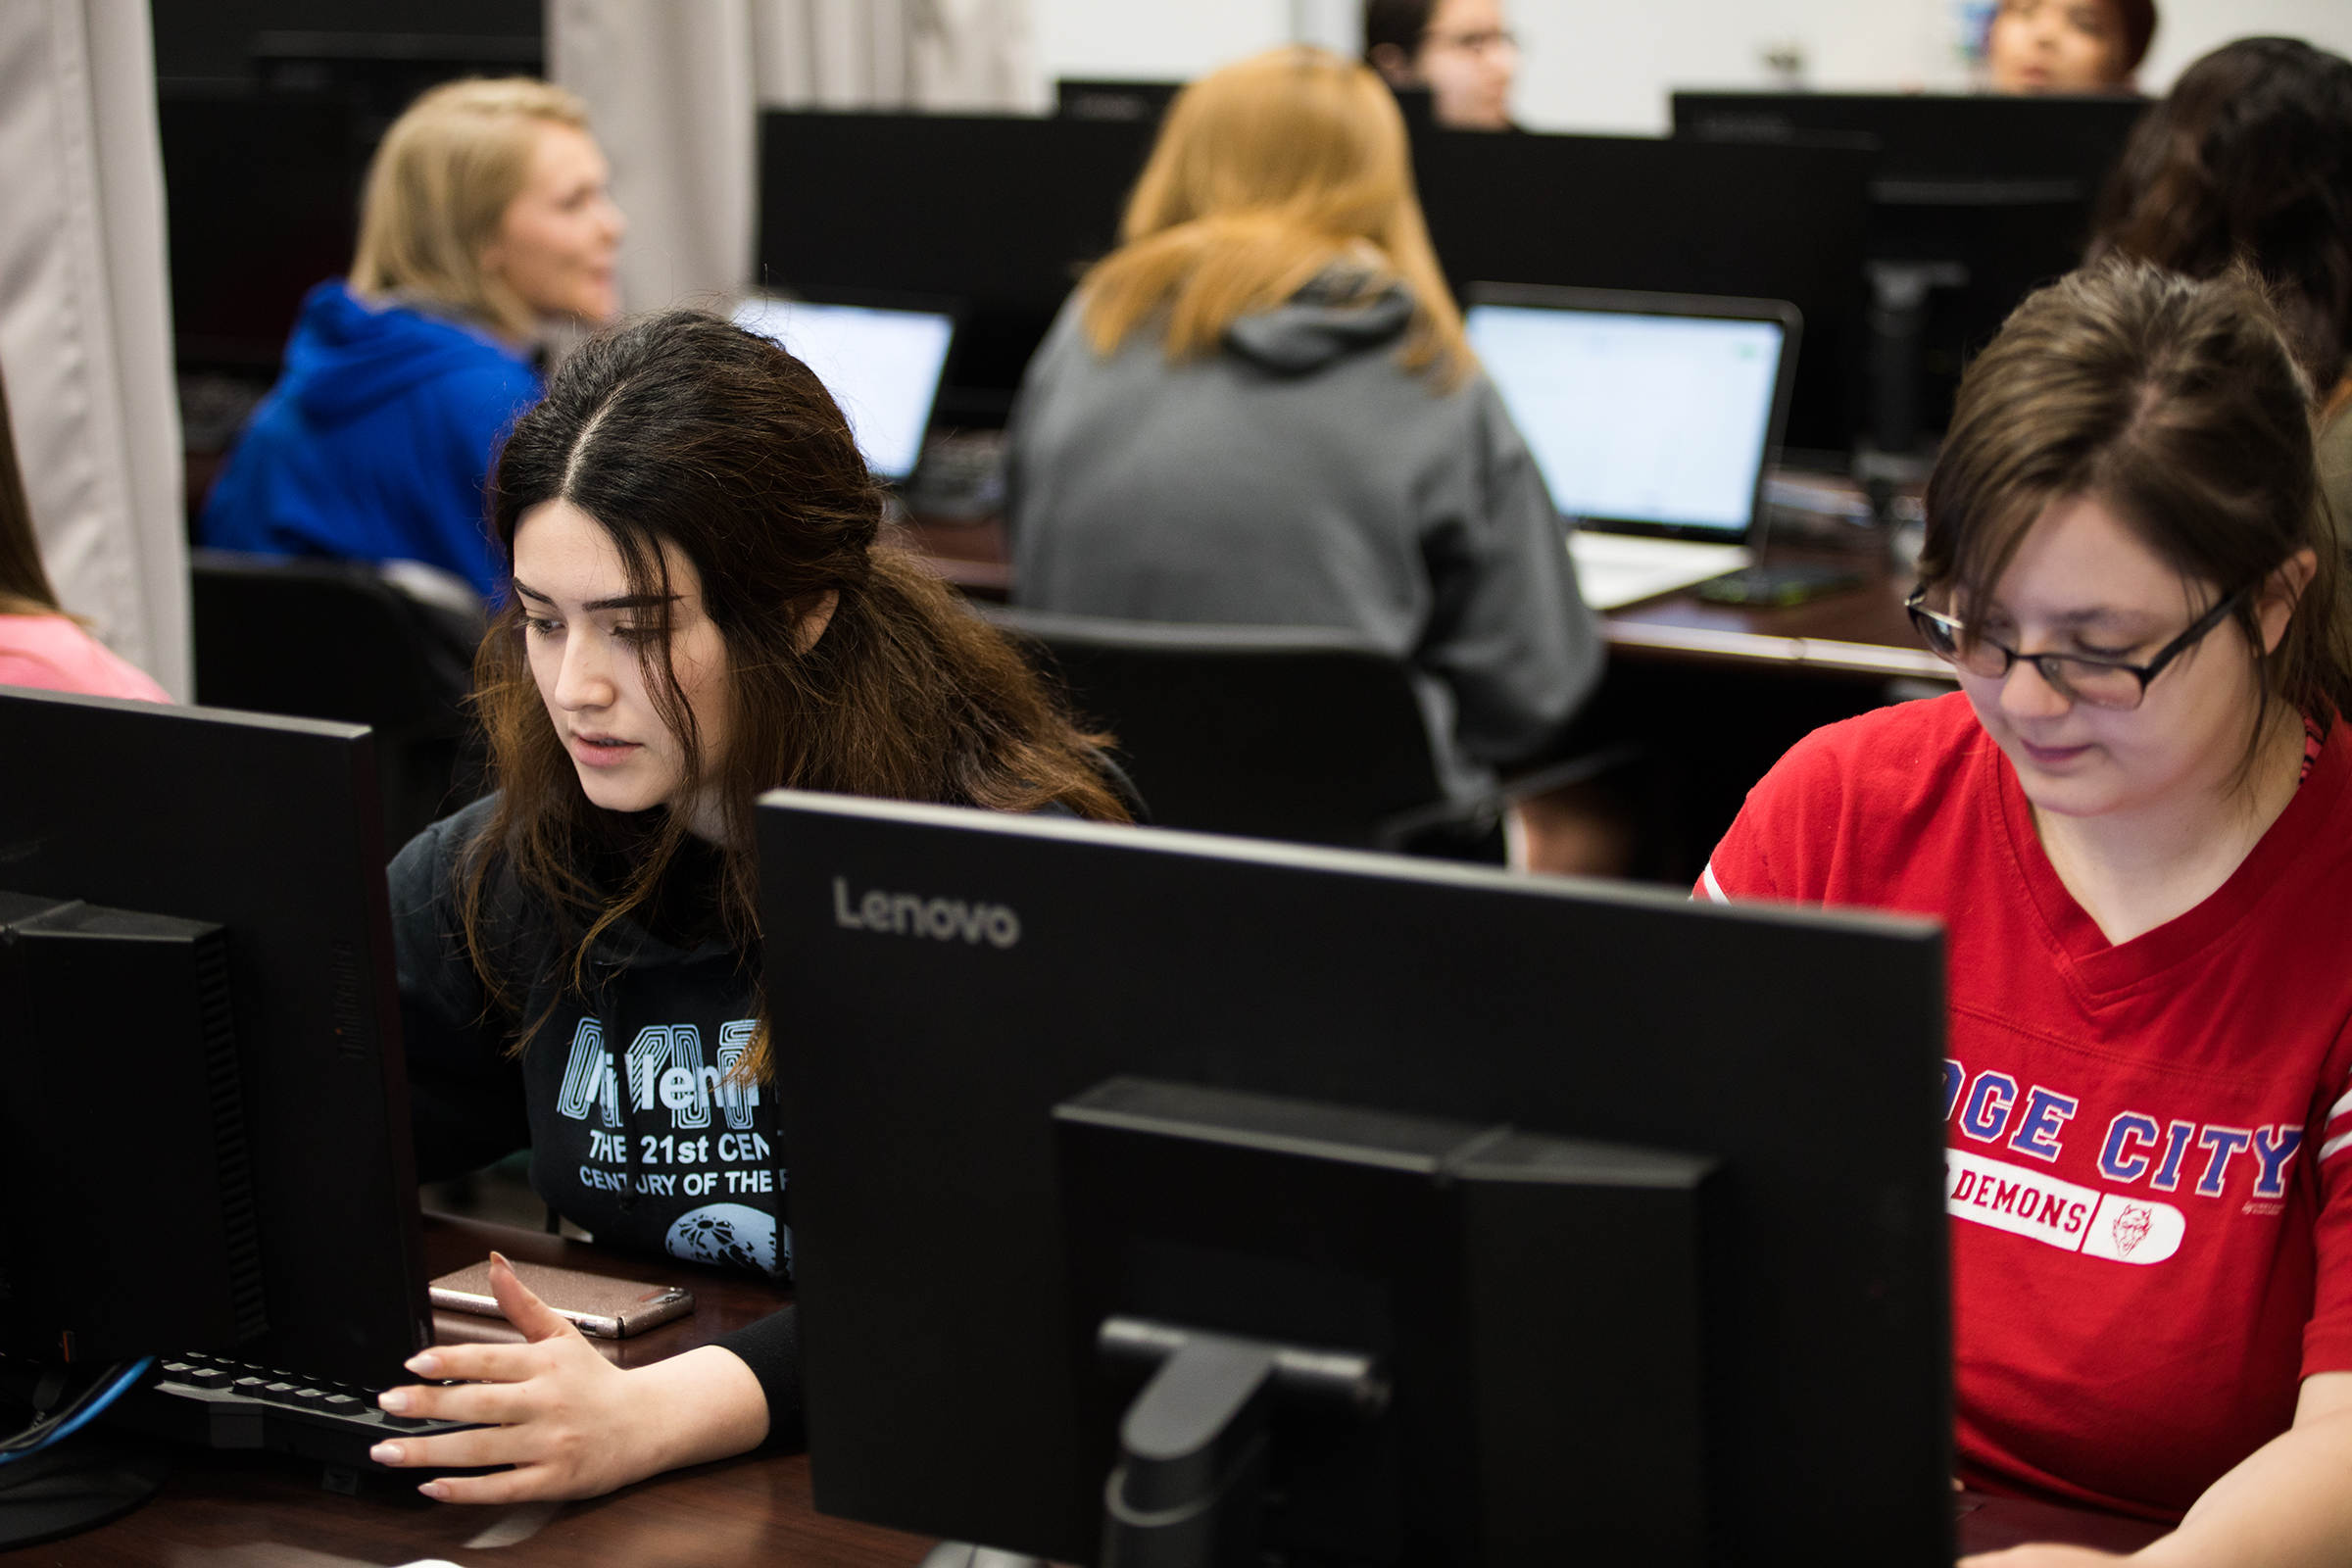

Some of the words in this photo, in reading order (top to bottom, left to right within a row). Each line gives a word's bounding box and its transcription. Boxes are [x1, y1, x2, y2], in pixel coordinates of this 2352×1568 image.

[834, 876, 1021, 950] Lenovo
[589, 1129, 627, 1164] THE
[640, 1134, 710, 1164] 21st
[718, 1130, 784, 1163] CEN
[2097, 1110, 2304, 1199] CITY
[683, 1171, 718, 1197] OF
[724, 1168, 773, 1194] THE
[1950, 1168, 2088, 1235] DEMONS
